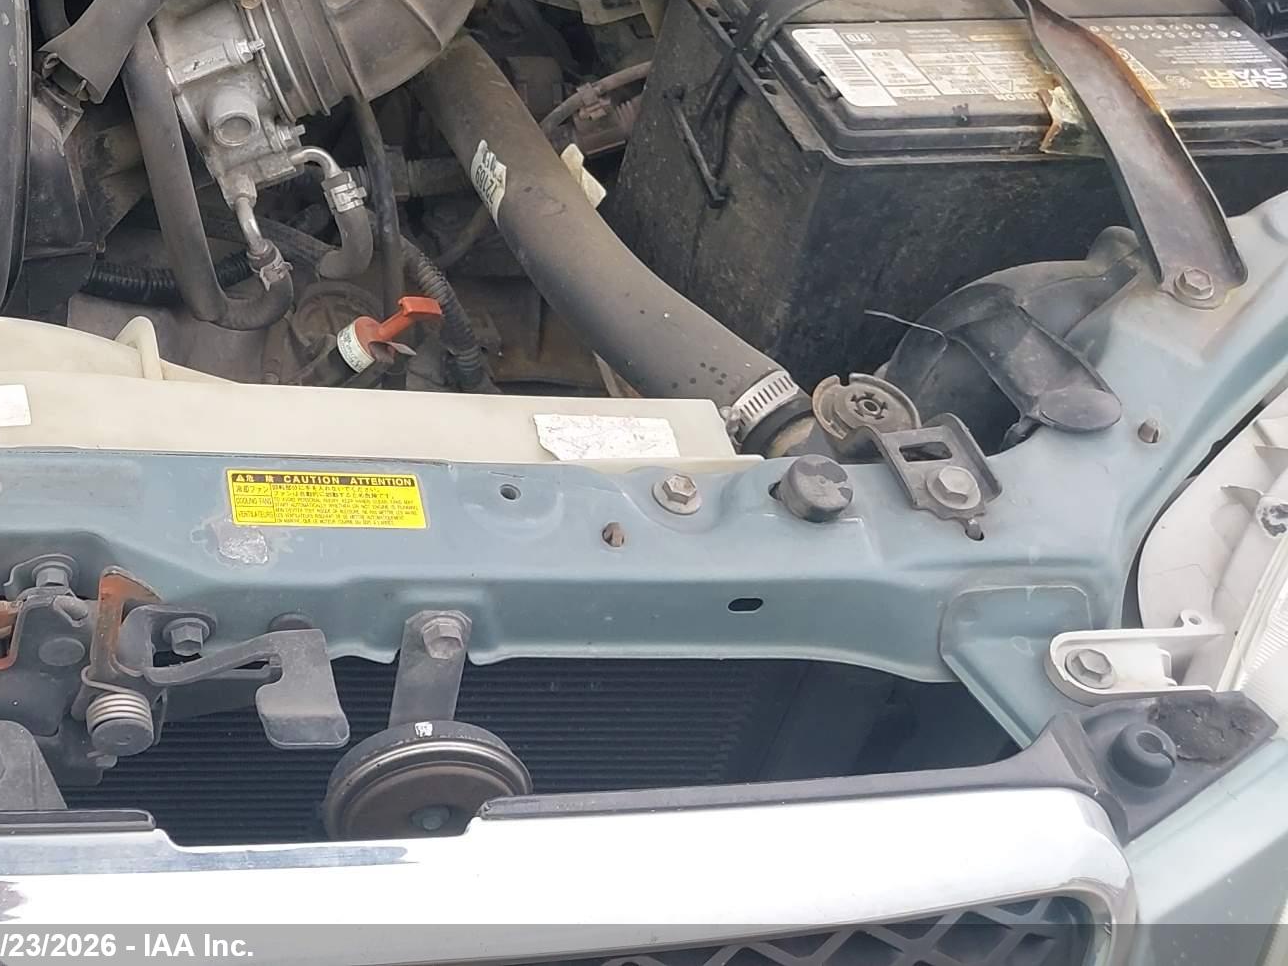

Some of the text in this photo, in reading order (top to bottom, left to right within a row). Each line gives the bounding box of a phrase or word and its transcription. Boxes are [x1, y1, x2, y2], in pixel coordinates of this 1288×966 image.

[1194, 66, 1288, 81] START
[1207, 78, 1288, 90] SUPER
[283, 475, 340, 485] CAUTION
[350, 477, 412, 486] ATTENTION
